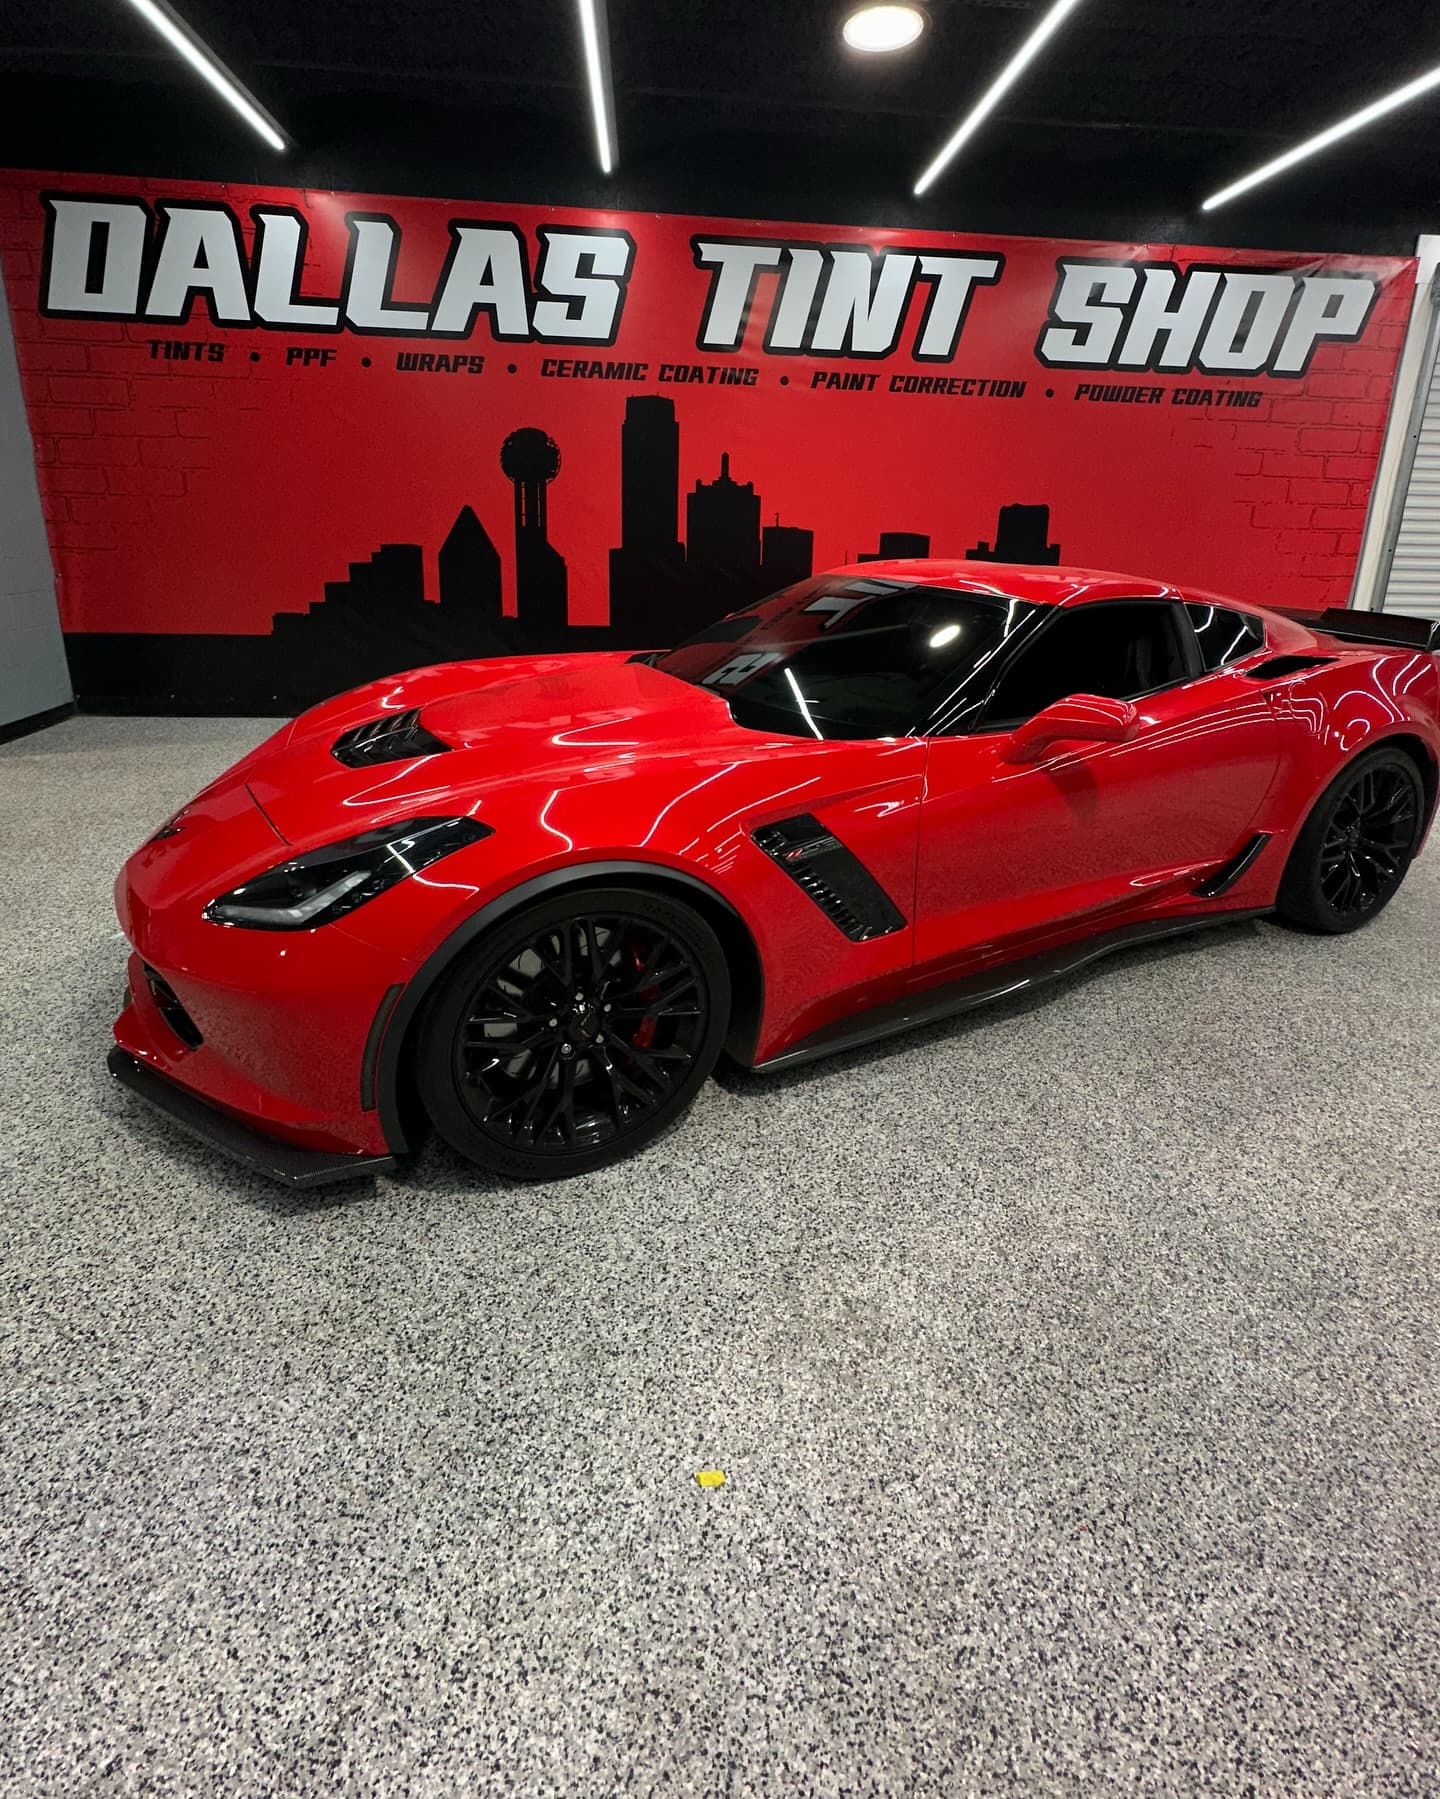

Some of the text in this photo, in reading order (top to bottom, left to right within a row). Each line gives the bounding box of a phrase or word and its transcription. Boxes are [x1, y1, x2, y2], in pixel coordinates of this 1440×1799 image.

[45, 198, 1377, 372] DALLAS TINT SHOP
[149, 339, 1263, 408] TINTS PPF WRAPS CERAMIC COATING PAINT CORRECTION POWDER COATING
